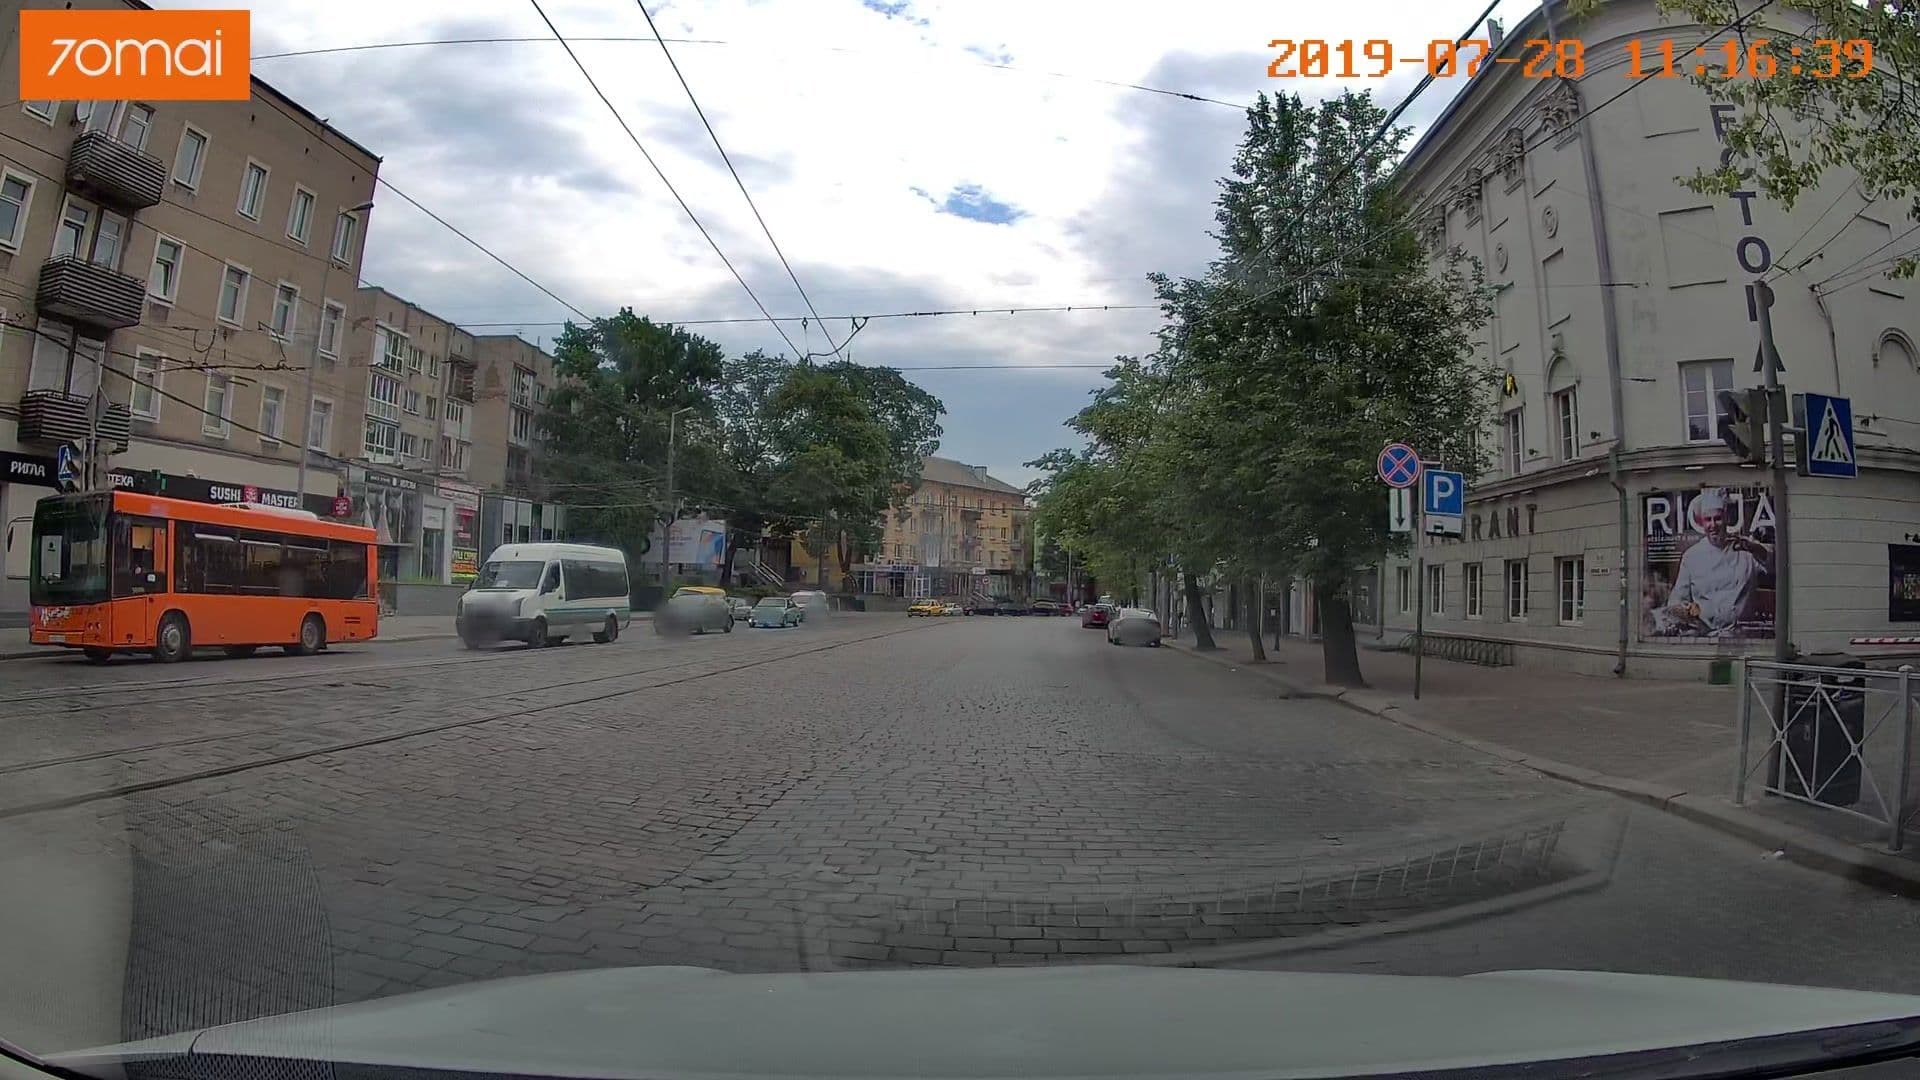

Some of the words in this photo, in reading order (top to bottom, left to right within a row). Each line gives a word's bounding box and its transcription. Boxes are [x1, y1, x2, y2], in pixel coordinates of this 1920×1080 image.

[10, 460, 46, 477] РИГЛА
[210, 486, 241, 502] SUSHI
[1433, 475, 1455, 509] P
